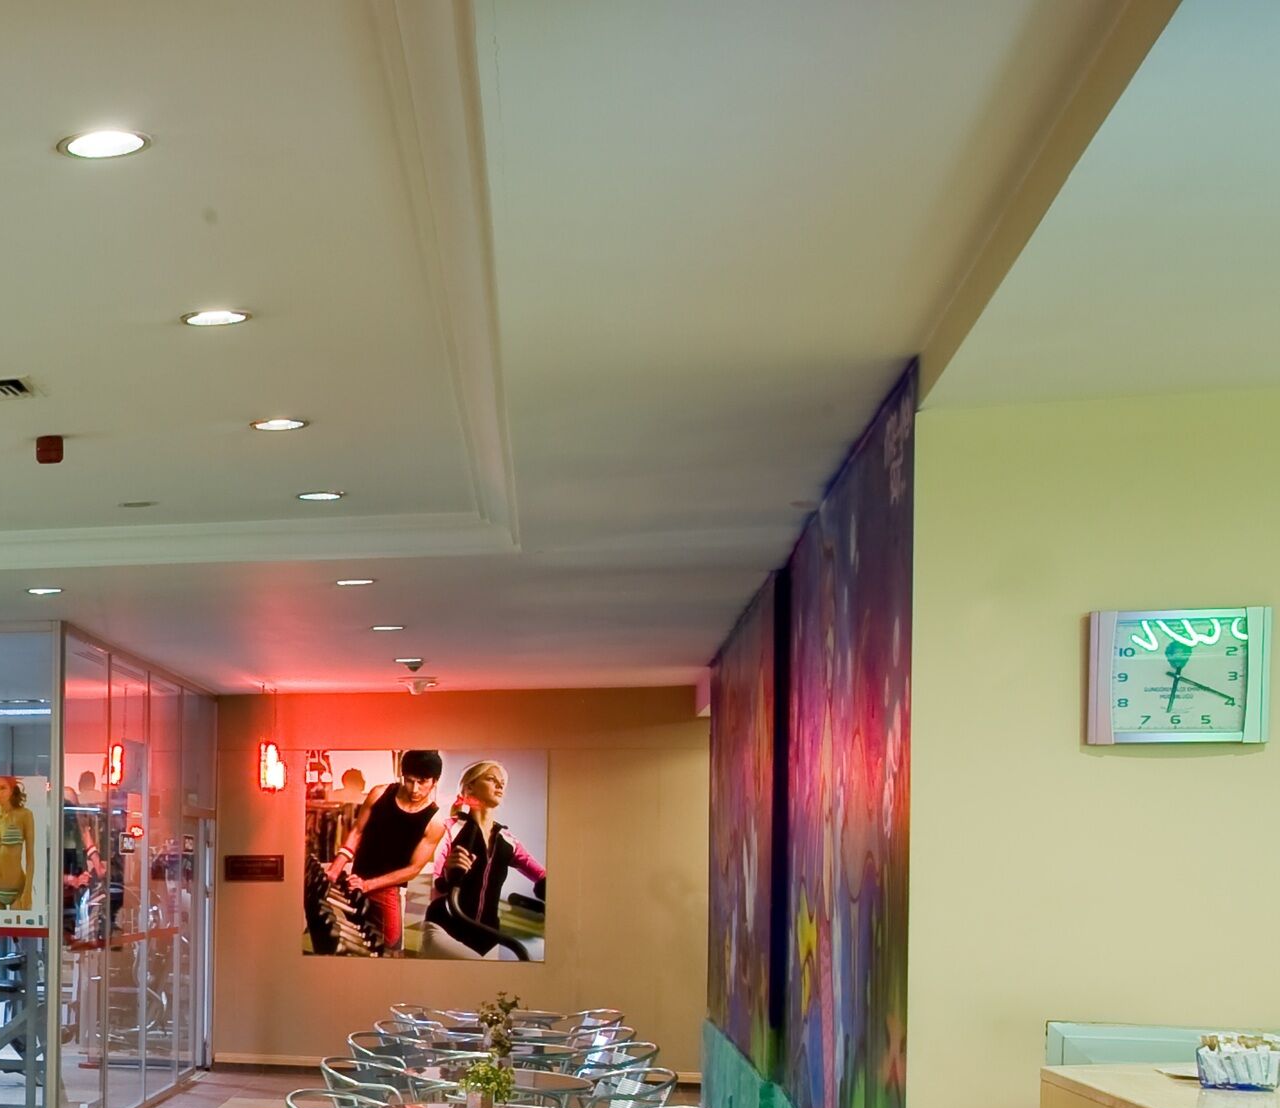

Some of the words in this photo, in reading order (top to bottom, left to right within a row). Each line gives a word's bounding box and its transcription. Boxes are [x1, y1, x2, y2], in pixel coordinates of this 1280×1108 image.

[1119, 648, 1136, 657] 10
[1226, 646, 1238, 656] 2
[1117, 672, 1129, 683] 9
[1228, 671, 1238, 682] 3
[1117, 698, 1129, 708] 8
[1140, 715, 1152, 726] 7
[1170, 714, 1181, 725] 6
[1201, 715, 1211, 725] 5
